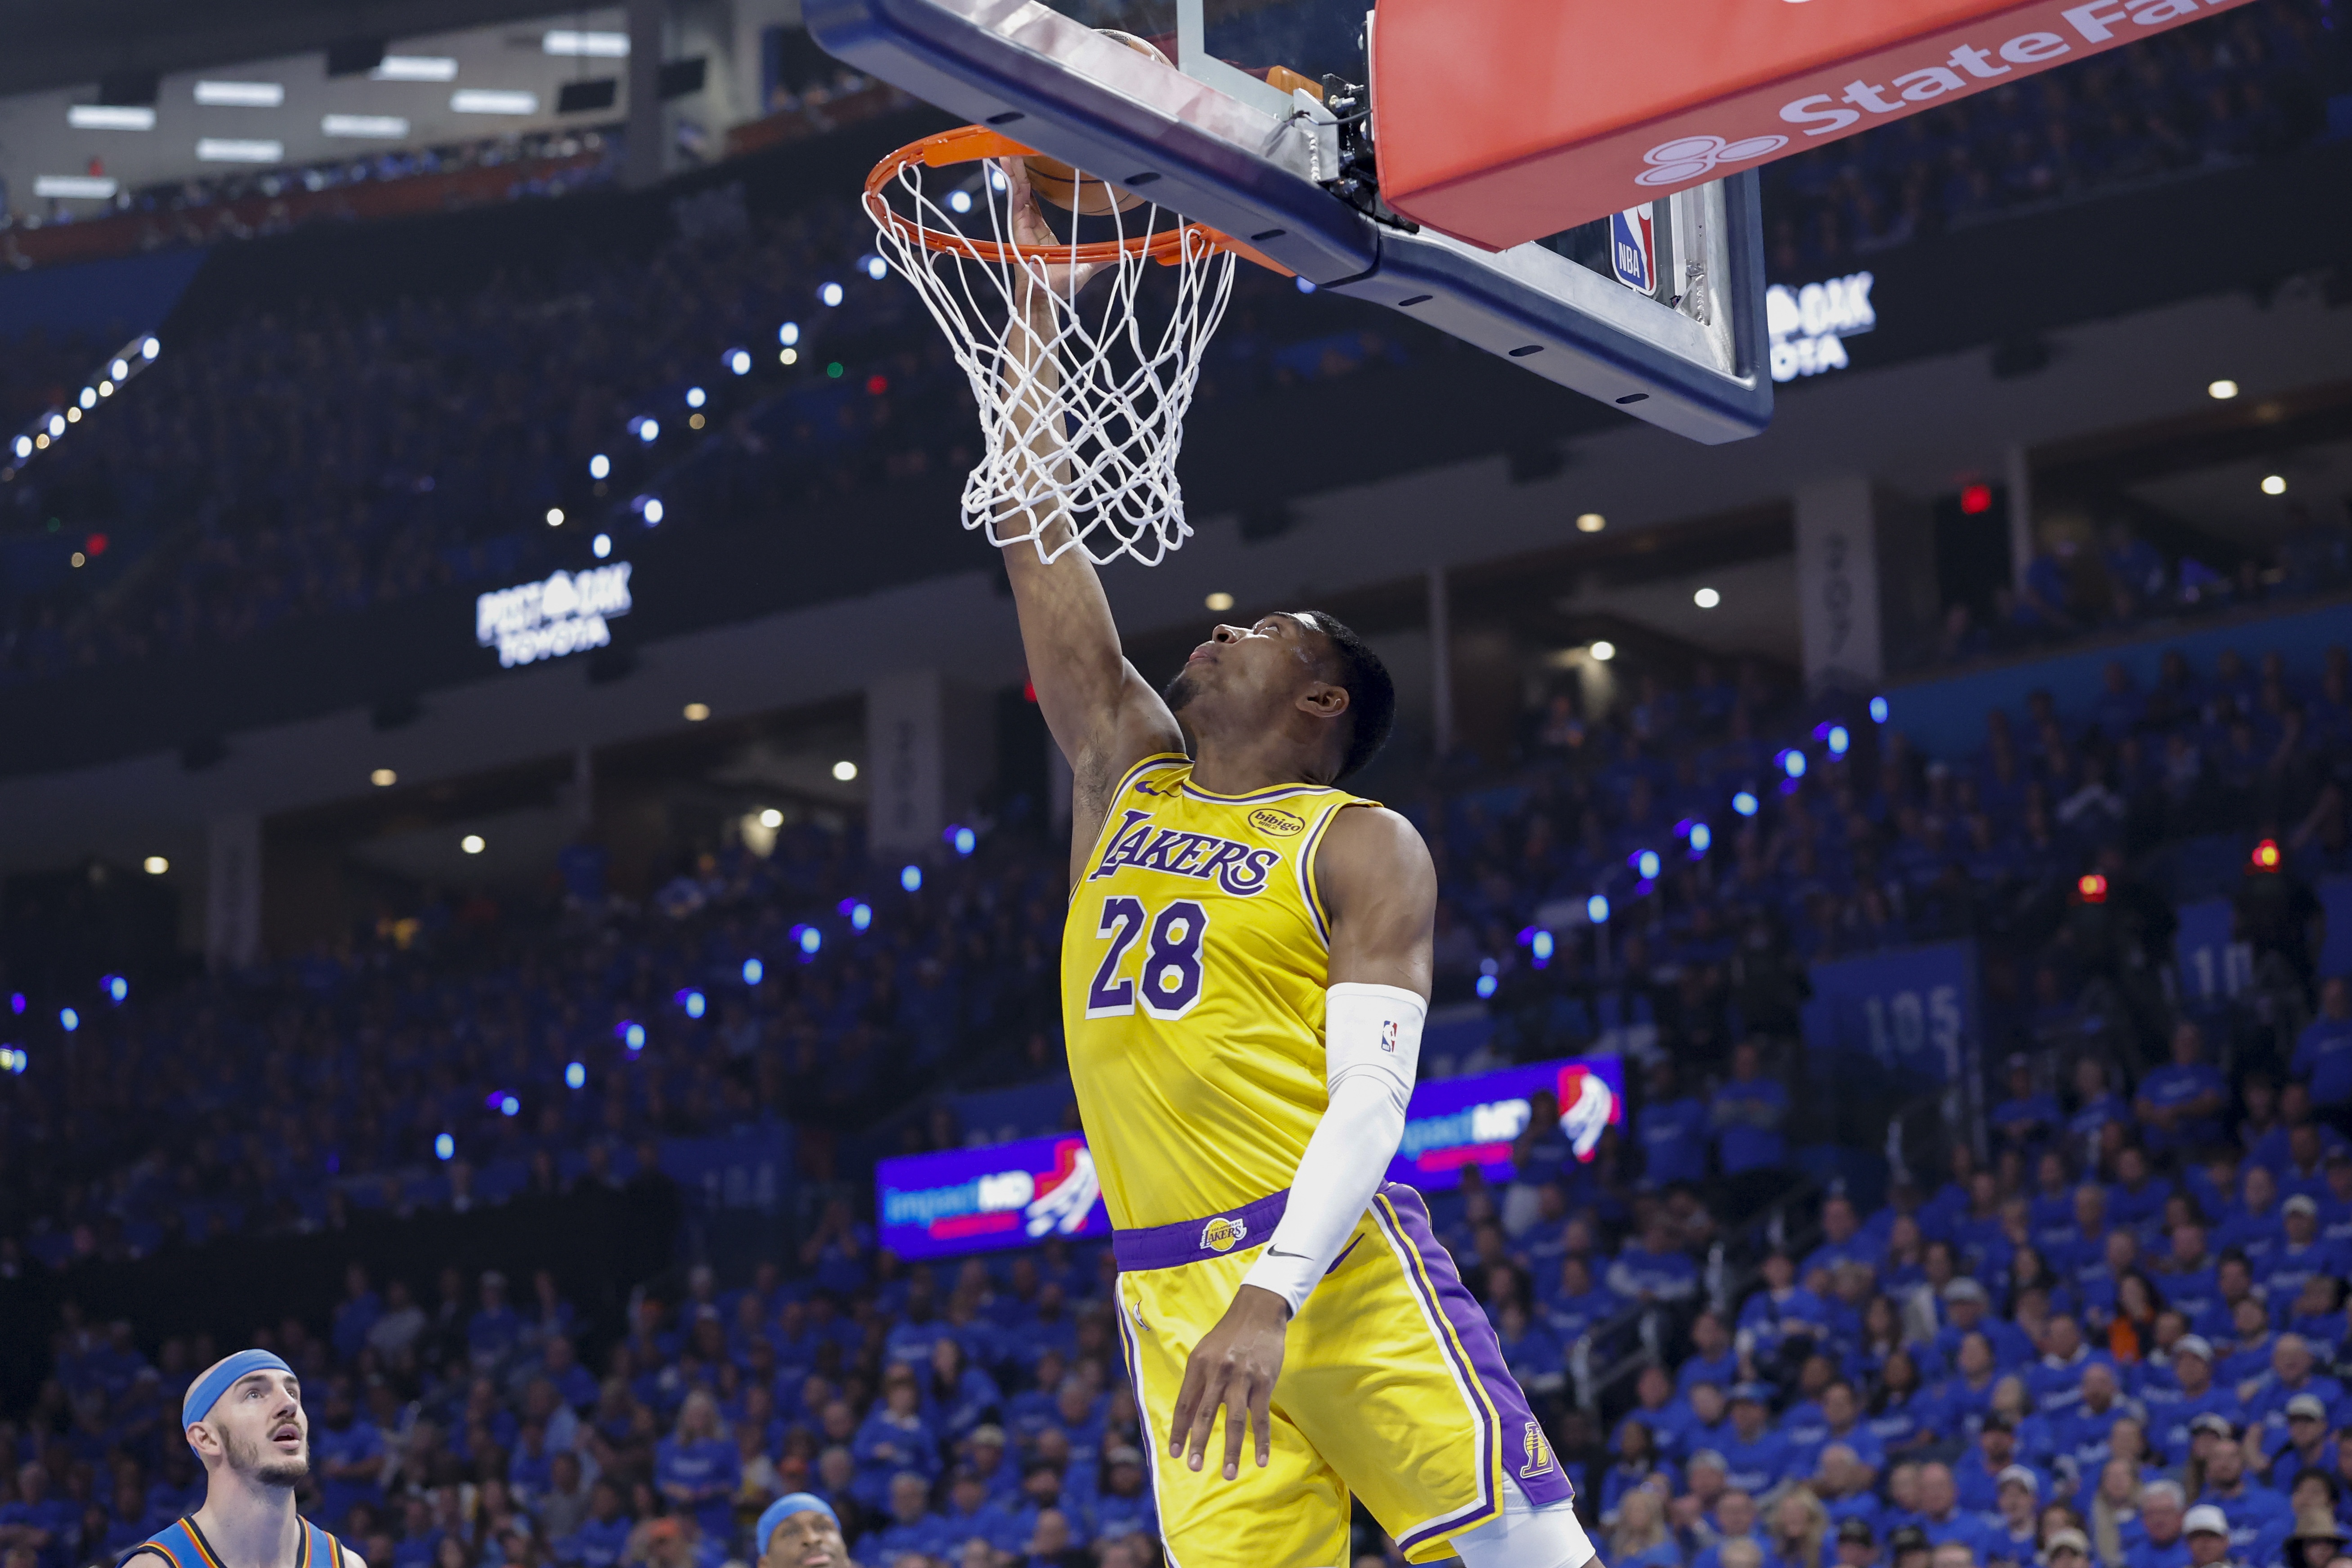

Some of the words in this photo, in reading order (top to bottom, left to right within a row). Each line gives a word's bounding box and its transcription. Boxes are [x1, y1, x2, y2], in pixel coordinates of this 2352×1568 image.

[1779, 31, 2071, 136] State
[2061, 0, 2222, 44] Fa
[1618, 241, 1641, 278] NBA
[1254, 811, 1301, 831] bibigo
[1086, 808, 1283, 898] LAKERS
[1085, 895, 1210, 1021] 28
[1203, 1225, 1245, 1247] LAKERS
